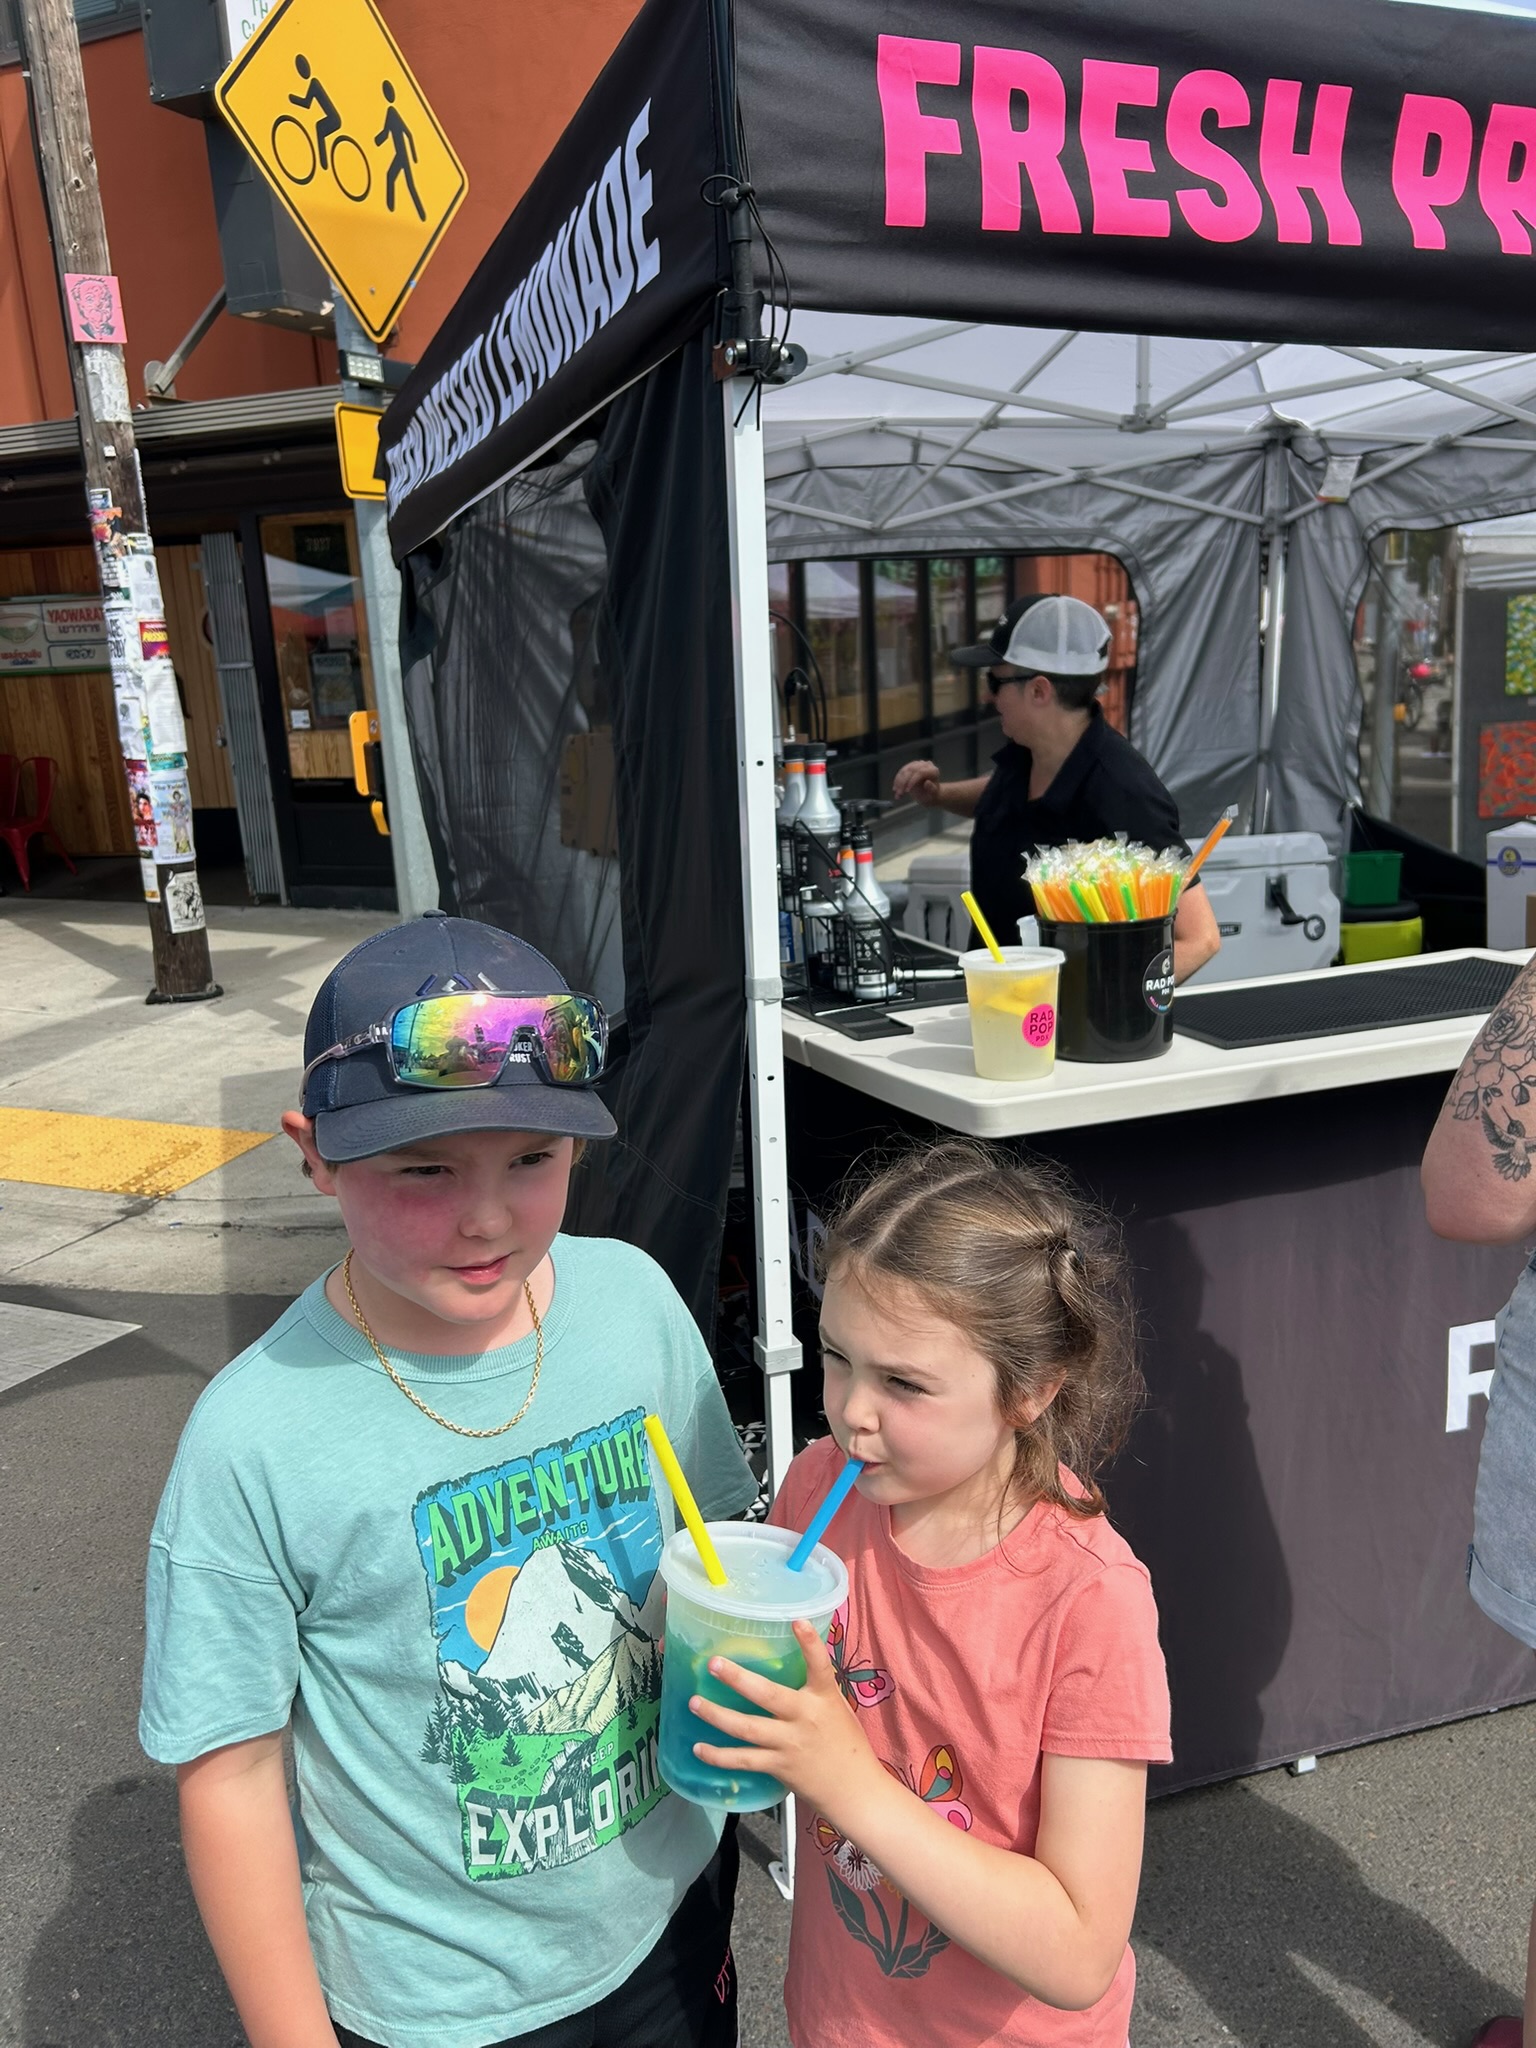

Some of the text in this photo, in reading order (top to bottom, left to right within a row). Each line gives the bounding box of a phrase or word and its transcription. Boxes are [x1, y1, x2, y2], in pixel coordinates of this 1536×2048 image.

[877, 34, 1363, 244] FRESH
[486, 97, 661, 427] LEMONADE
[1145, 978, 1166, 991] RAD
[1029, 1021, 1054, 1035] POP
[1030, 1009, 1054, 1024] RAD
[427, 1418, 650, 1586] ADVENTURE
[532, 1519, 589, 1551] AWAITS
[580, 1741, 614, 1771] KEEP
